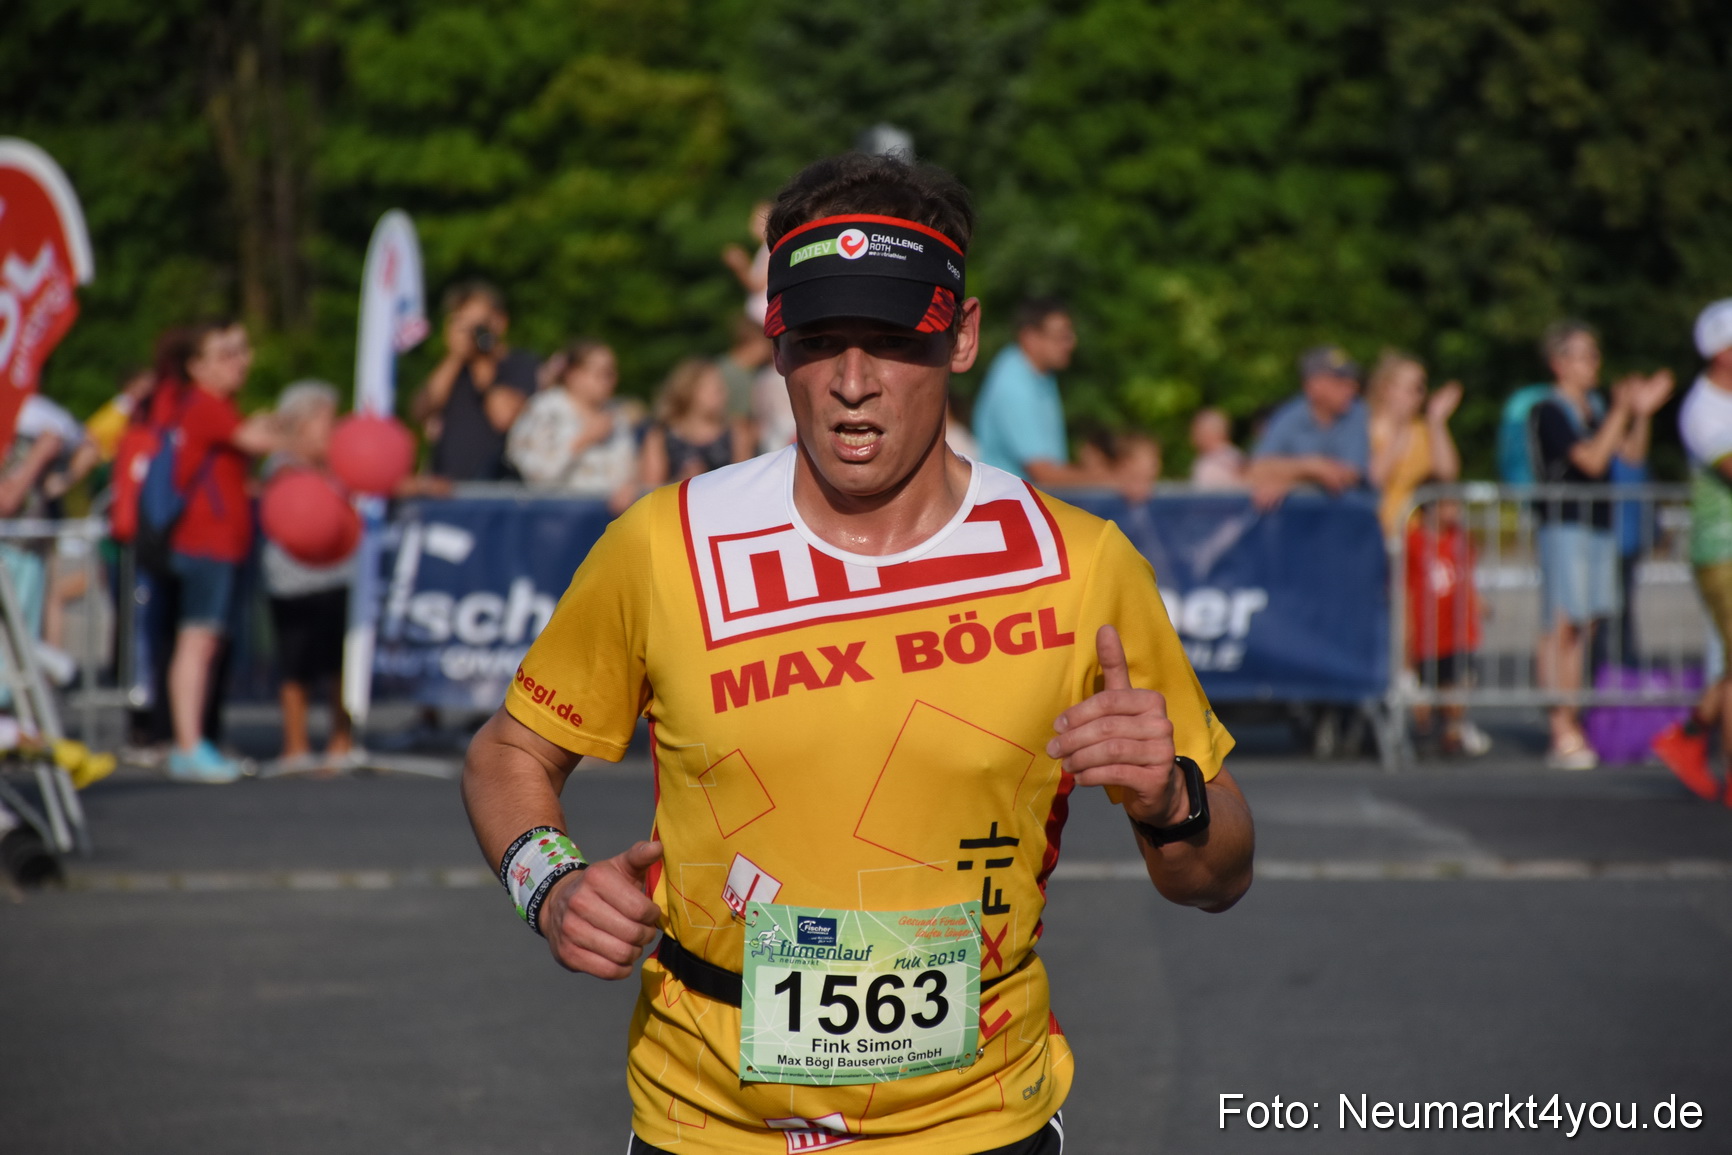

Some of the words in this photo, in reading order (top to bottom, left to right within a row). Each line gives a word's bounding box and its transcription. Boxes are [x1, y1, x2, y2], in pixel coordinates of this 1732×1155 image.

[794, 241, 832, 264] DATEV
[869, 242, 891, 253] ROTH
[871, 233, 924, 253] CHALLENGE
[710, 640, 875, 715] MAX
[895, 606, 1075, 674] BÖGL
[803, 923, 832, 933] Fischer
[780, 939, 874, 961] firmenlauf
[893, 956, 922, 970] run
[927, 949, 967, 968] 2019
[779, 957, 820, 967] neumarkt
[774, 969, 950, 1036] 1563
[811, 1038, 851, 1054] Fink
[856, 1038, 913, 1054] Simon
[777, 1054, 802, 1067] Max
[805, 1056, 834, 1070] Bögl
[837, 1055, 904, 1068] Bauservice
[907, 1047, 942, 1063] GmbH
